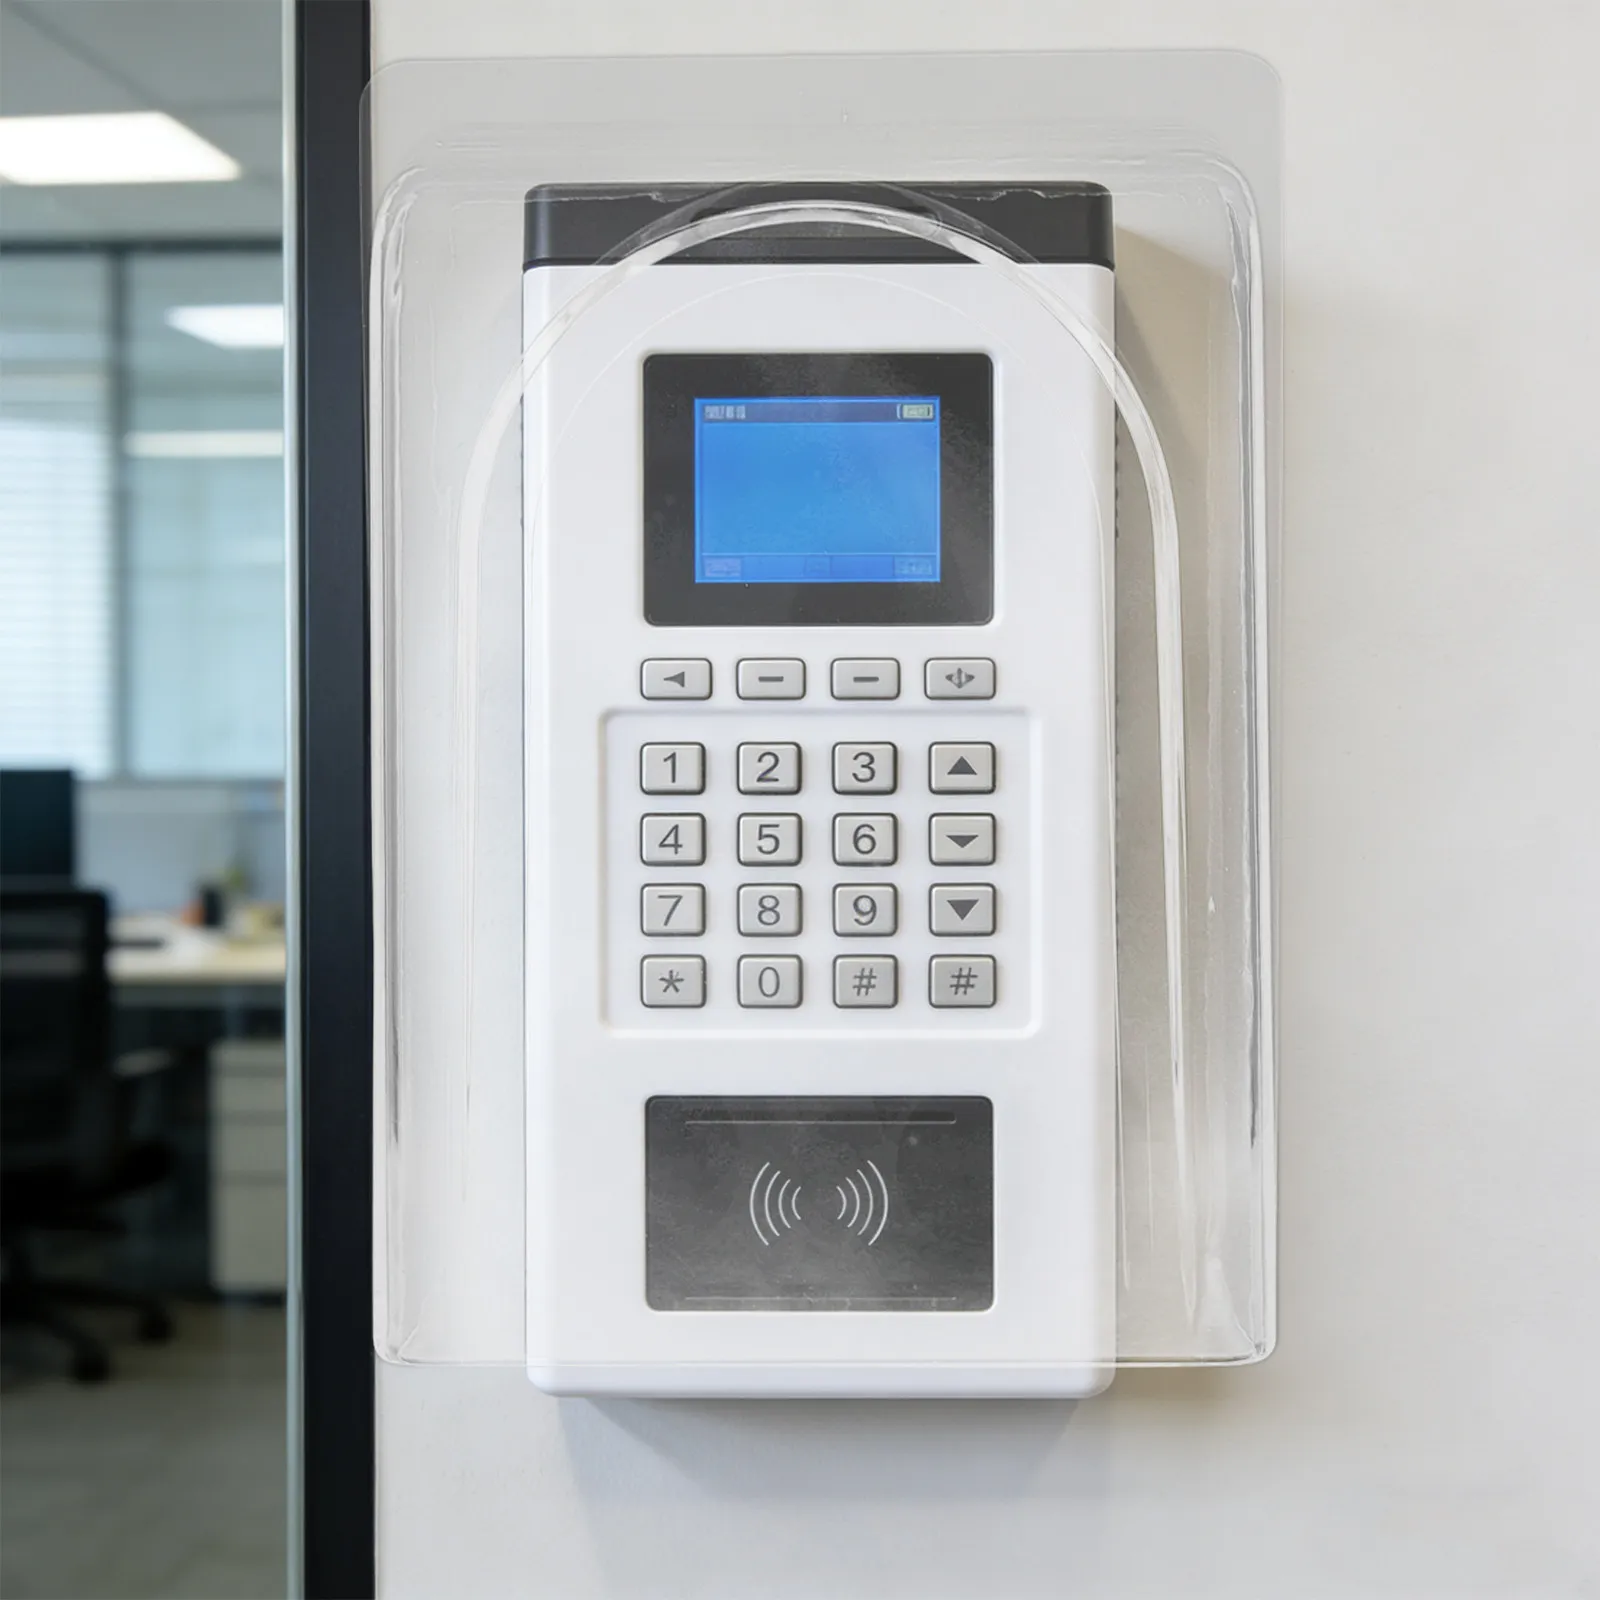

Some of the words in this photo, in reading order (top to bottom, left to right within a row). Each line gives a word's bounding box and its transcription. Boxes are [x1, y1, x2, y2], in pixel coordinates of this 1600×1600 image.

[664, 752, 676, 783] 1
[757, 752, 779, 782] 2
[852, 752, 875, 783] 3
[659, 824, 683, 854] 4
[757, 824, 780, 855] 5
[853, 824, 876, 855] 6
[658, 895, 682, 926] 7
[758, 895, 780, 925] 8
[853, 895, 877, 926] 9
[758, 967, 780, 997] 0
[853, 968, 877, 996] #
[950, 967, 978, 995] #
